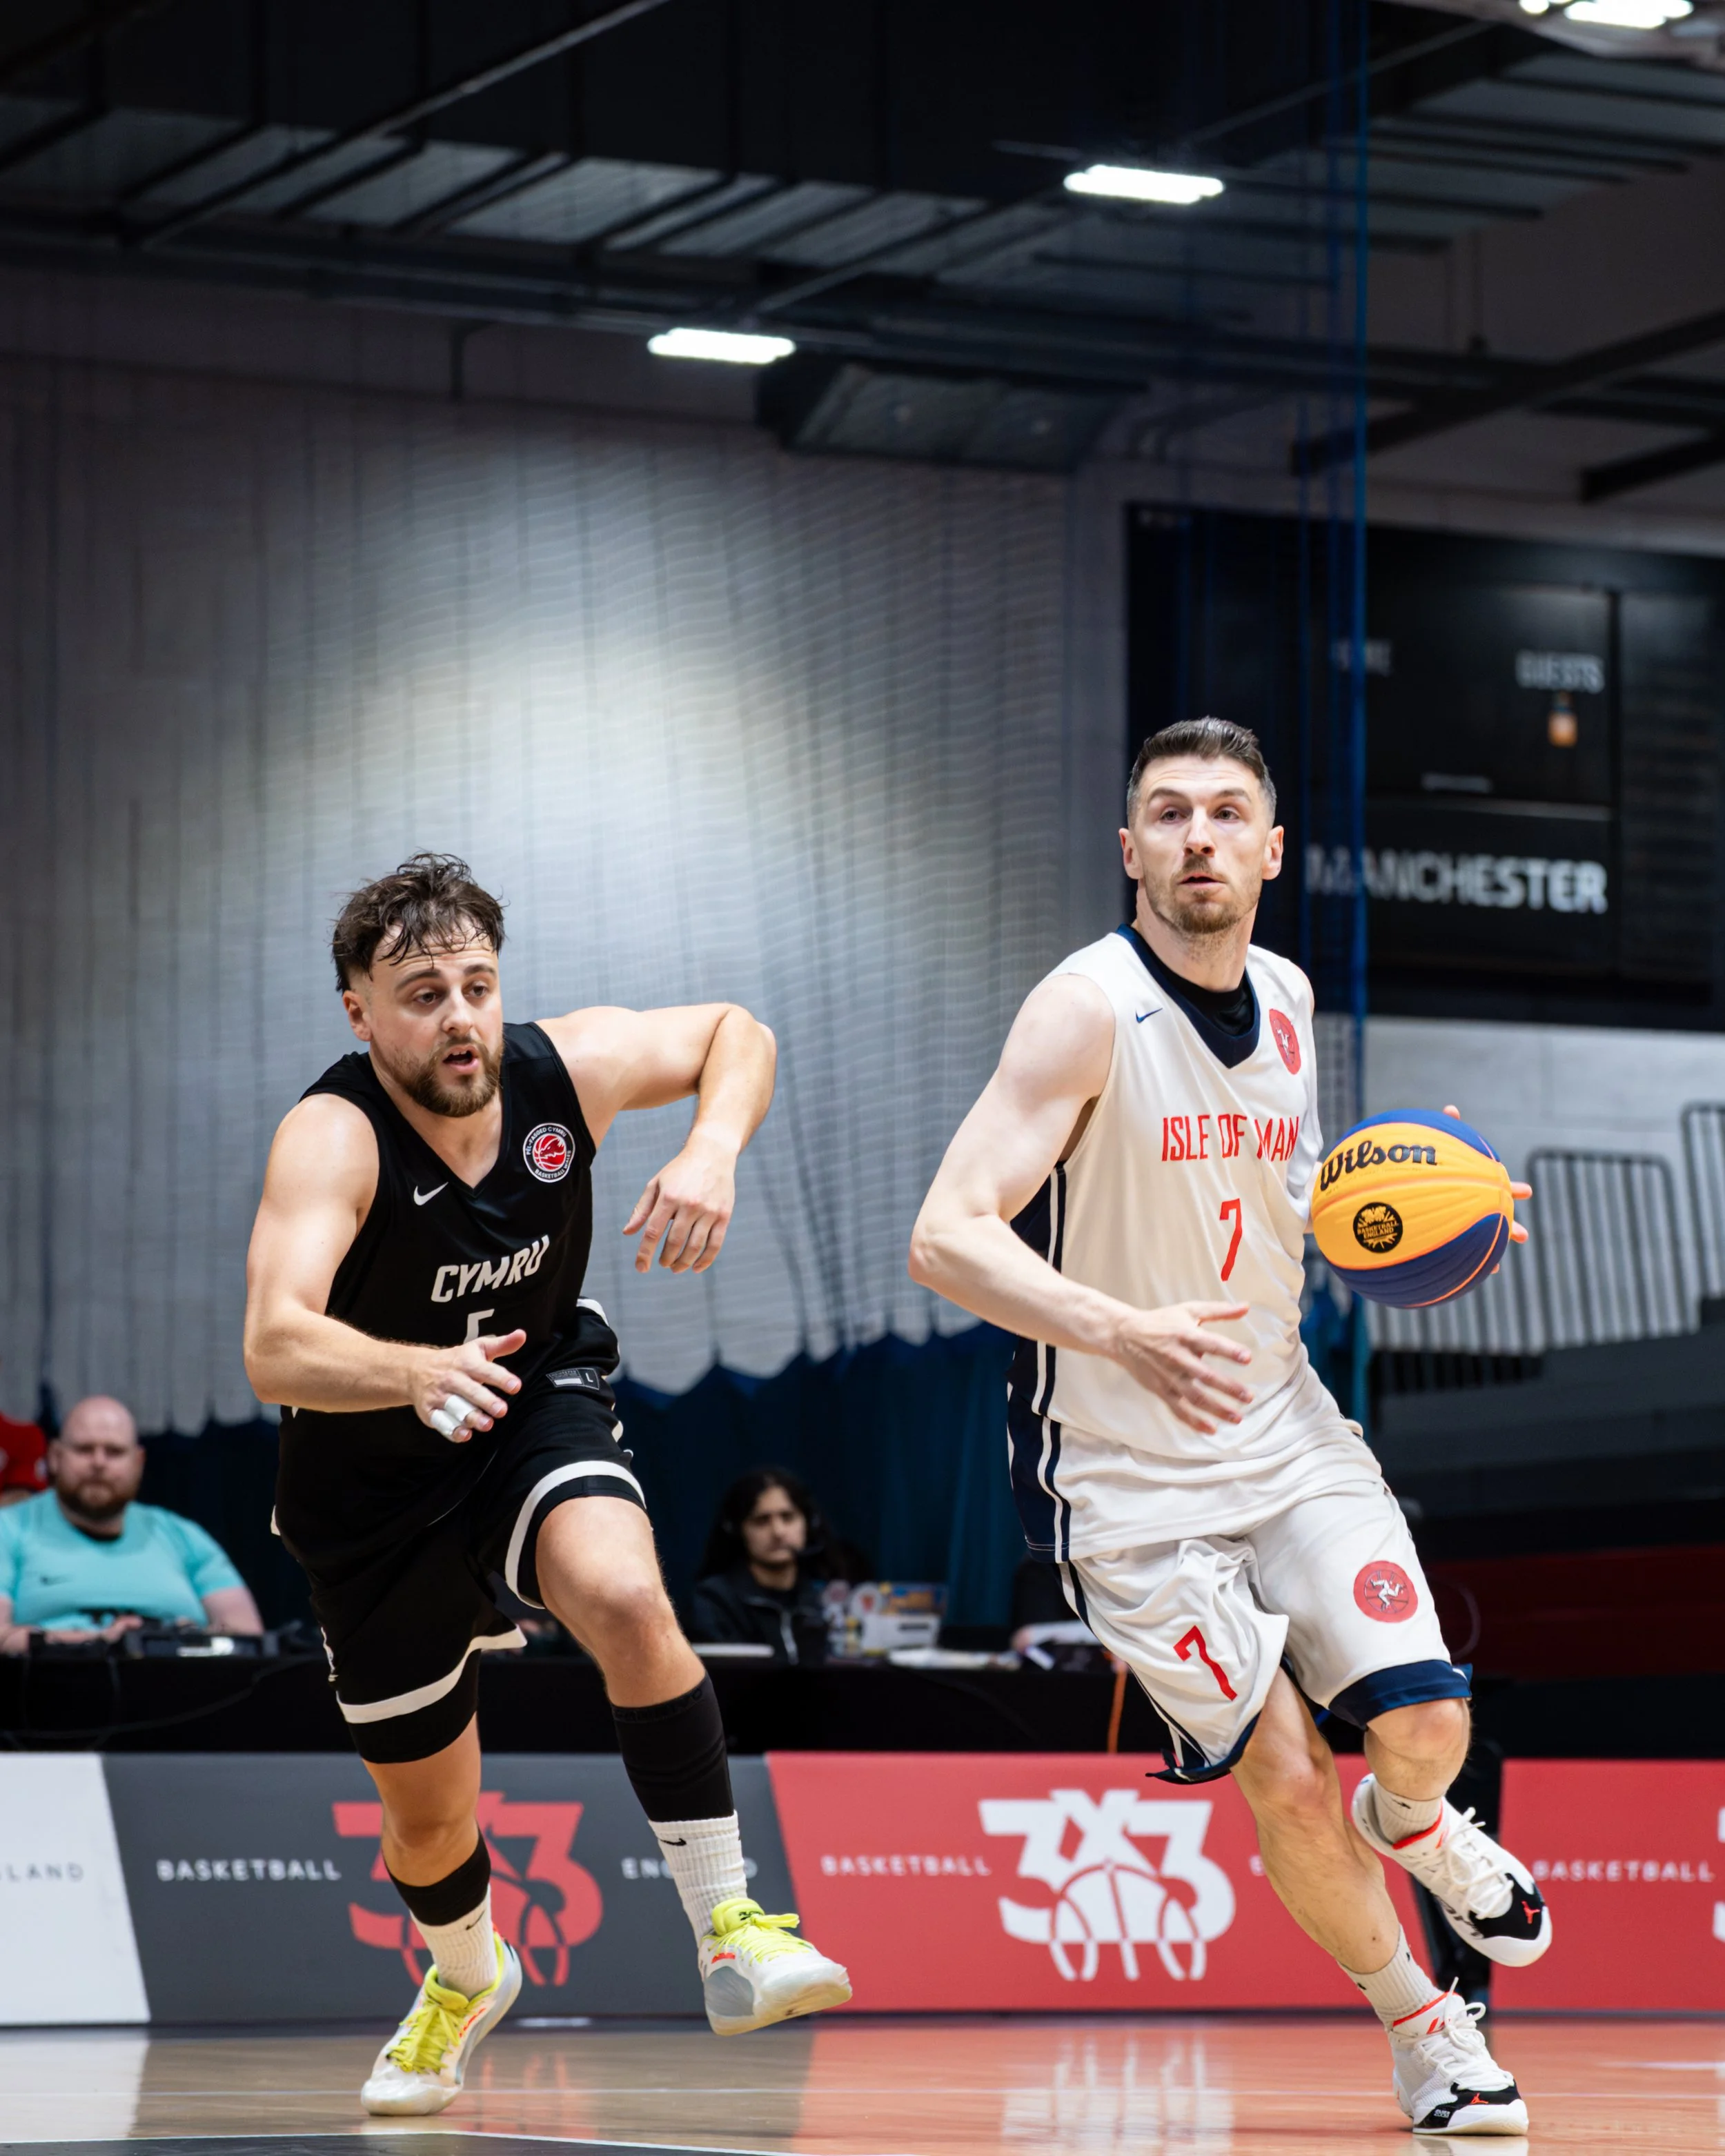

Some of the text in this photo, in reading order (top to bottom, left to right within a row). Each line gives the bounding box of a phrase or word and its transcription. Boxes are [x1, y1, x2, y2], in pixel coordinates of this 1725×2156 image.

[1305, 845, 1608, 914] MANCHESTER
[547, 1127, 567, 1137] CYMRU
[1162, 1114, 1299, 1162] ISLE OF MAN
[535, 1169, 566, 1179] BASKETBALL
[1320, 1140, 1437, 1191] Wilson
[1357, 1220, 1399, 1236] BASKETBALL
[1362, 1227, 1394, 1240] ENGLAND
[1219, 1198, 1243, 1282] 7
[431, 1234, 550, 1303] CYMRU
[1173, 1625, 1237, 1702] 7
[0, 1861, 84, 1883] LAND
[156, 1859, 341, 1881] BASKETBALL
[820, 1855, 992, 1877] BASKETBALL
[1532, 1859, 1715, 1882] BASKETBALL
